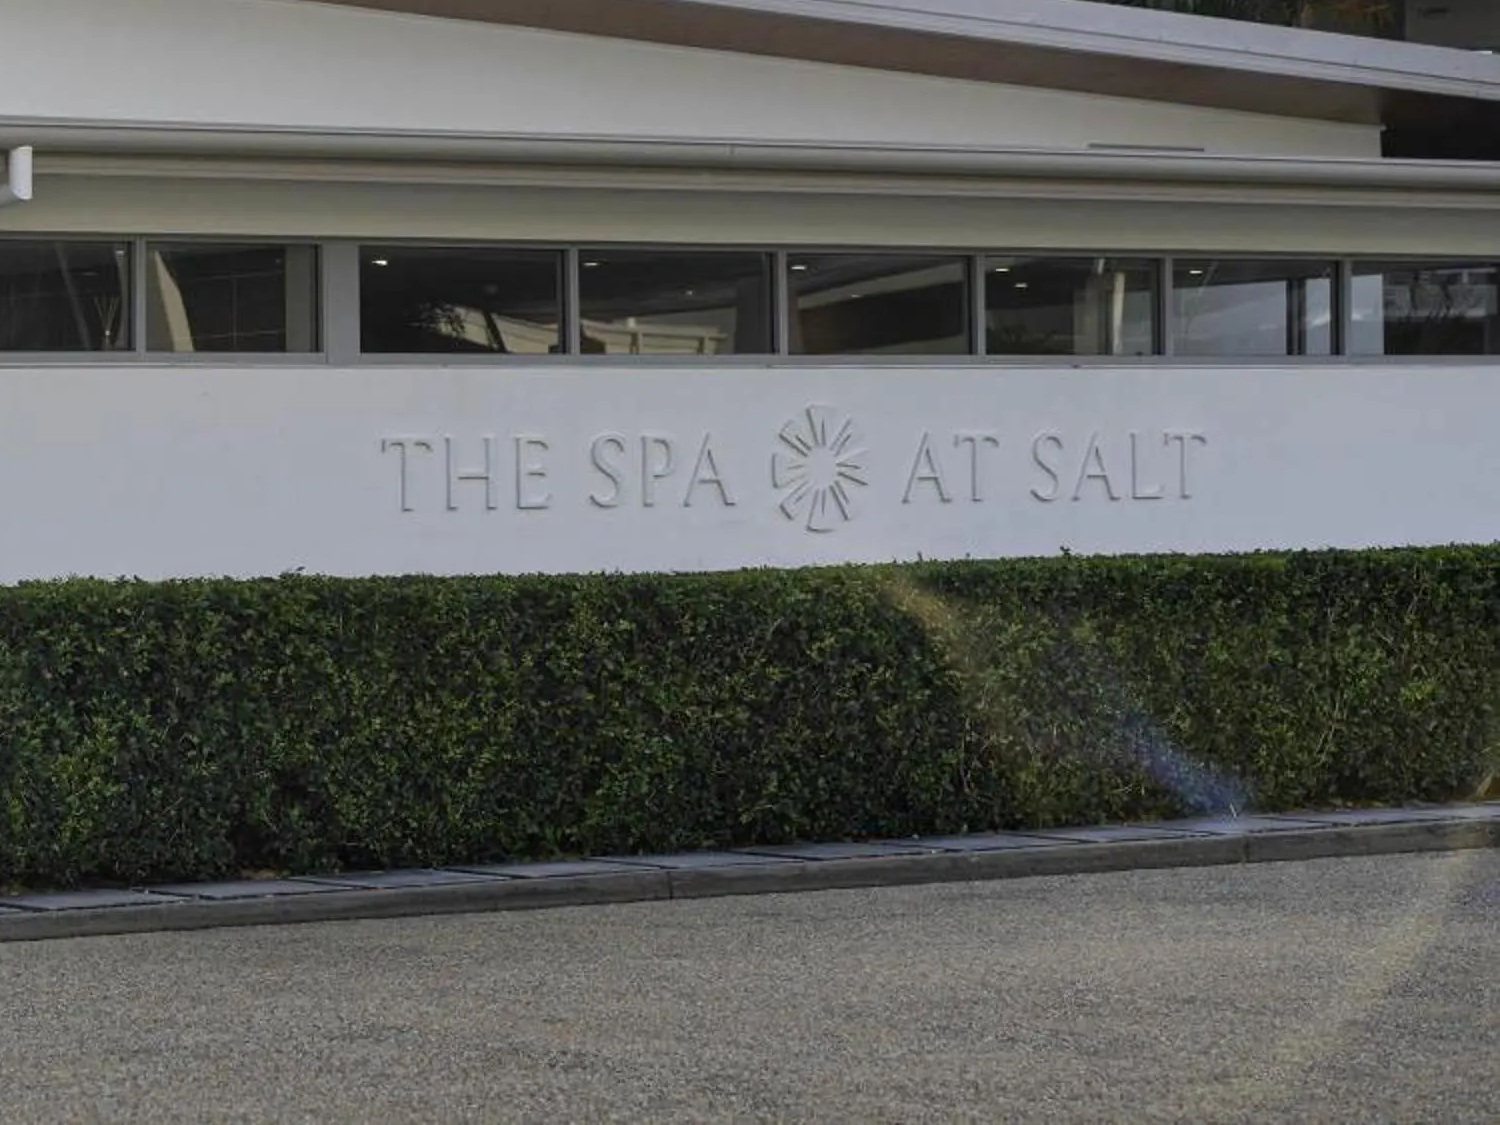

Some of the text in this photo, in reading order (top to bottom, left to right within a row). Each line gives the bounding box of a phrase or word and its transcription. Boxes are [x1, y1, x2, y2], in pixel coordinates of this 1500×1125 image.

[380, 430, 1208, 513] THE SPA AT SALT
